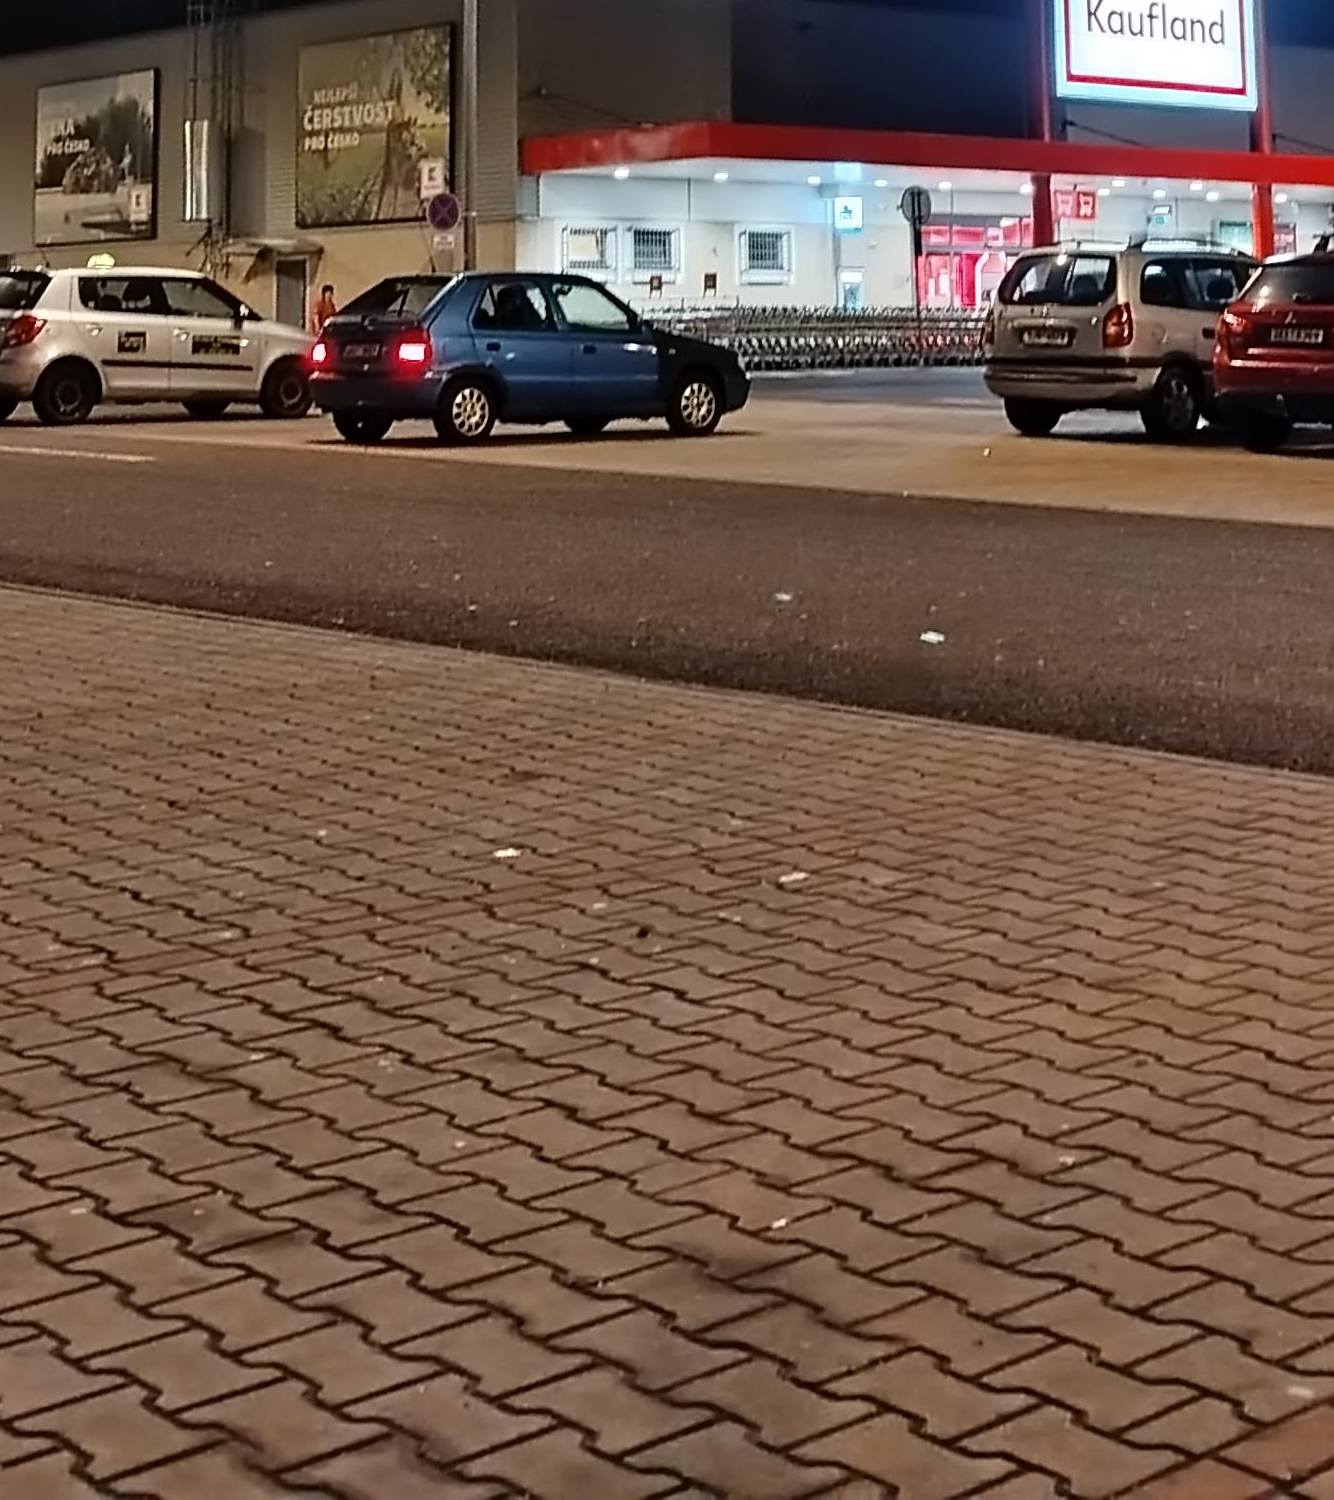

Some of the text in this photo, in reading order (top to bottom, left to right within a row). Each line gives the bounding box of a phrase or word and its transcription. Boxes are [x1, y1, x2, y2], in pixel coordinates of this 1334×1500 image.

[303, 101, 396, 131] ČERSTVOST
[304, 132, 360, 151] PRO ČESKO
